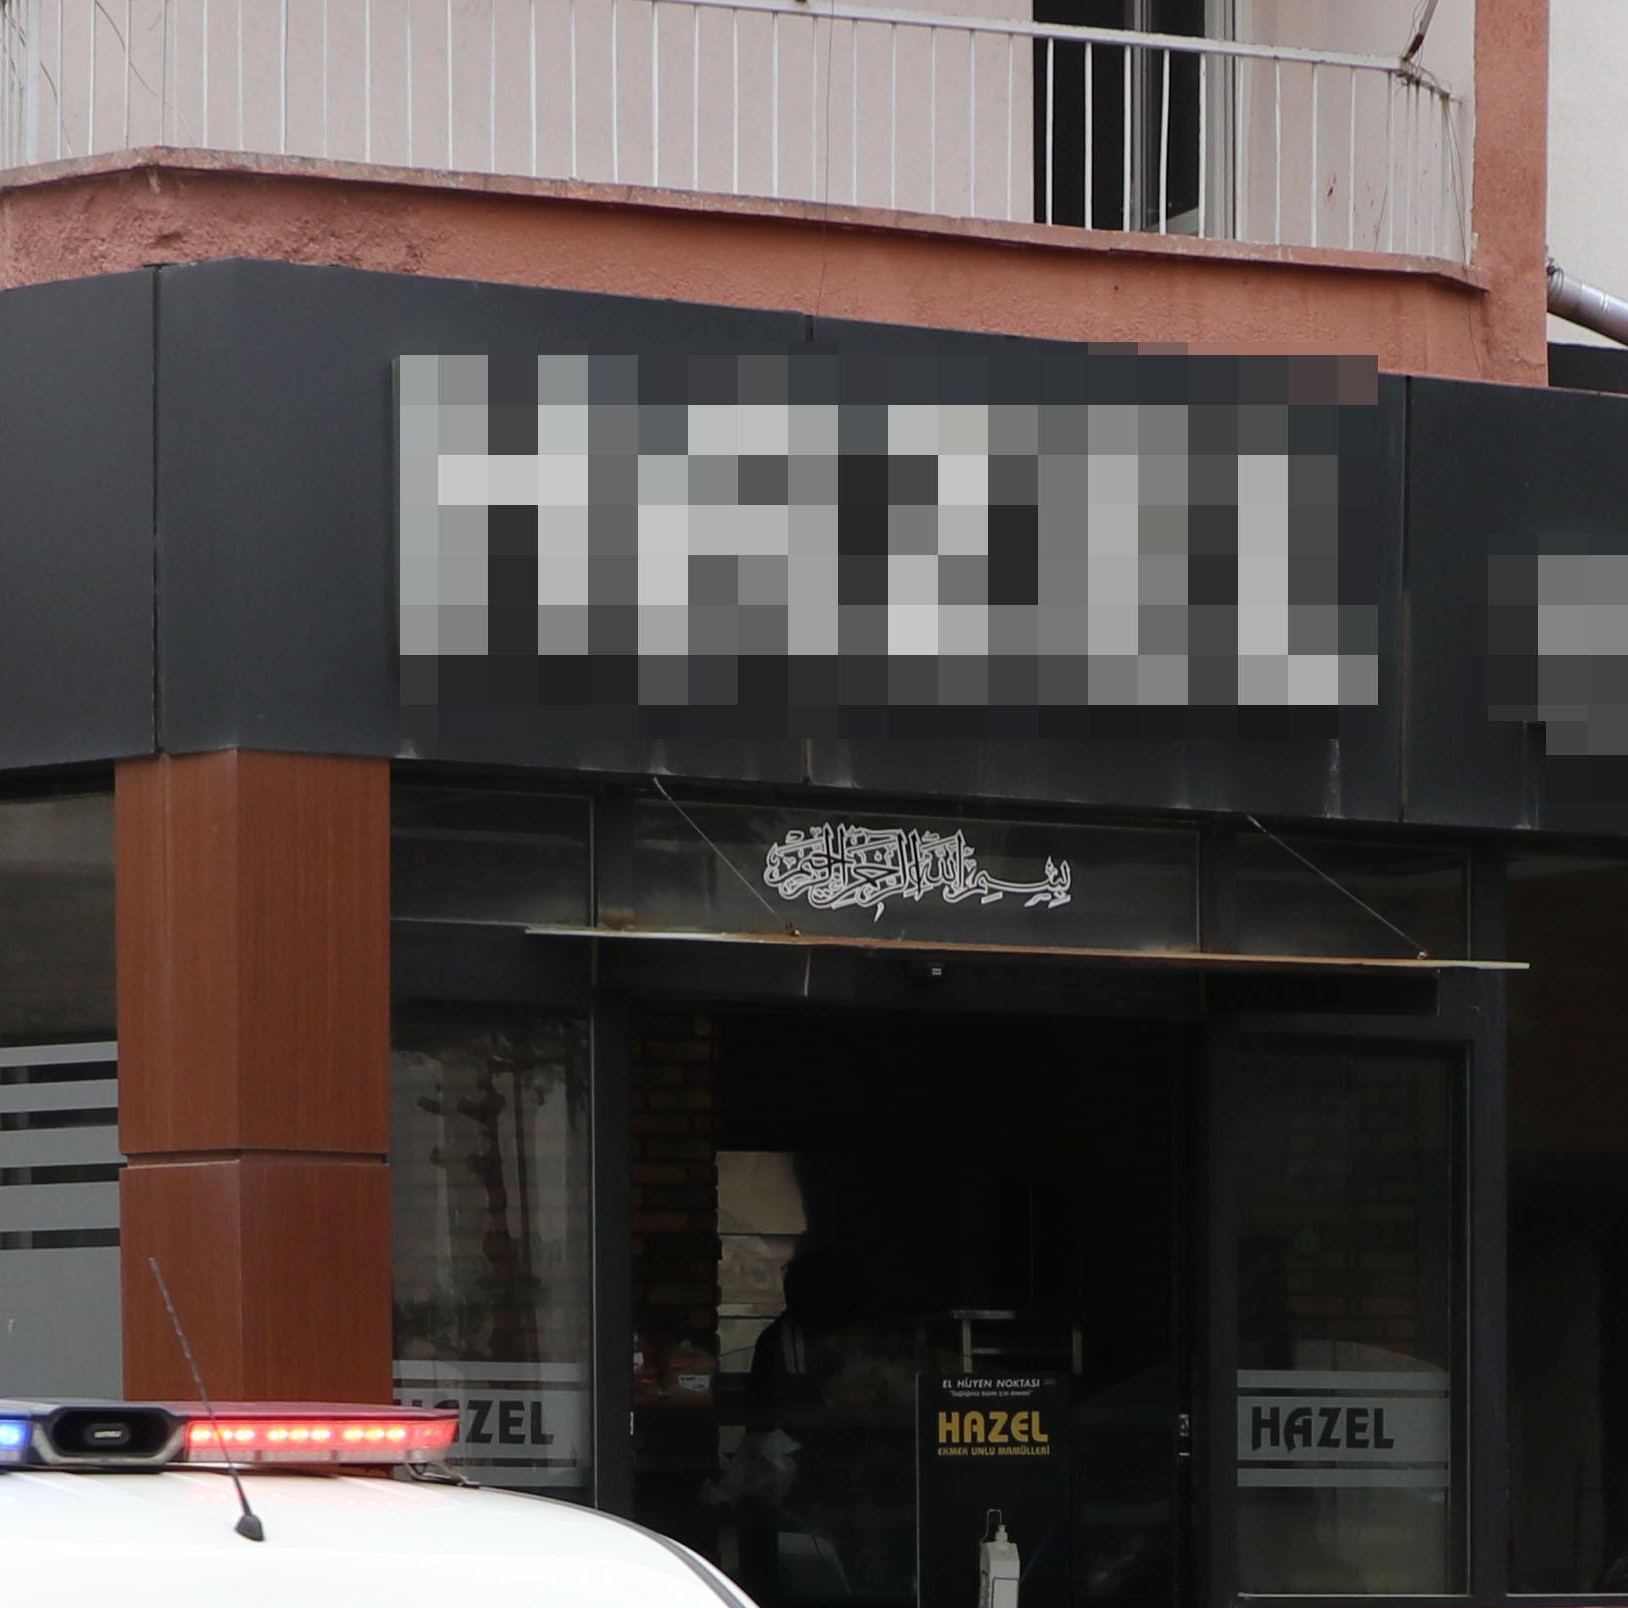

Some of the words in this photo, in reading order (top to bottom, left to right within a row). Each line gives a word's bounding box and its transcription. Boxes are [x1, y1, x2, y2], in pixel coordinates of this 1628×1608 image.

[942, 1380, 952, 1388] EL
[996, 1379, 1040, 1388] NOKTASI
[938, 1411, 1049, 1443] HAZEL
[1251, 1407, 1395, 1456] HAZEL
